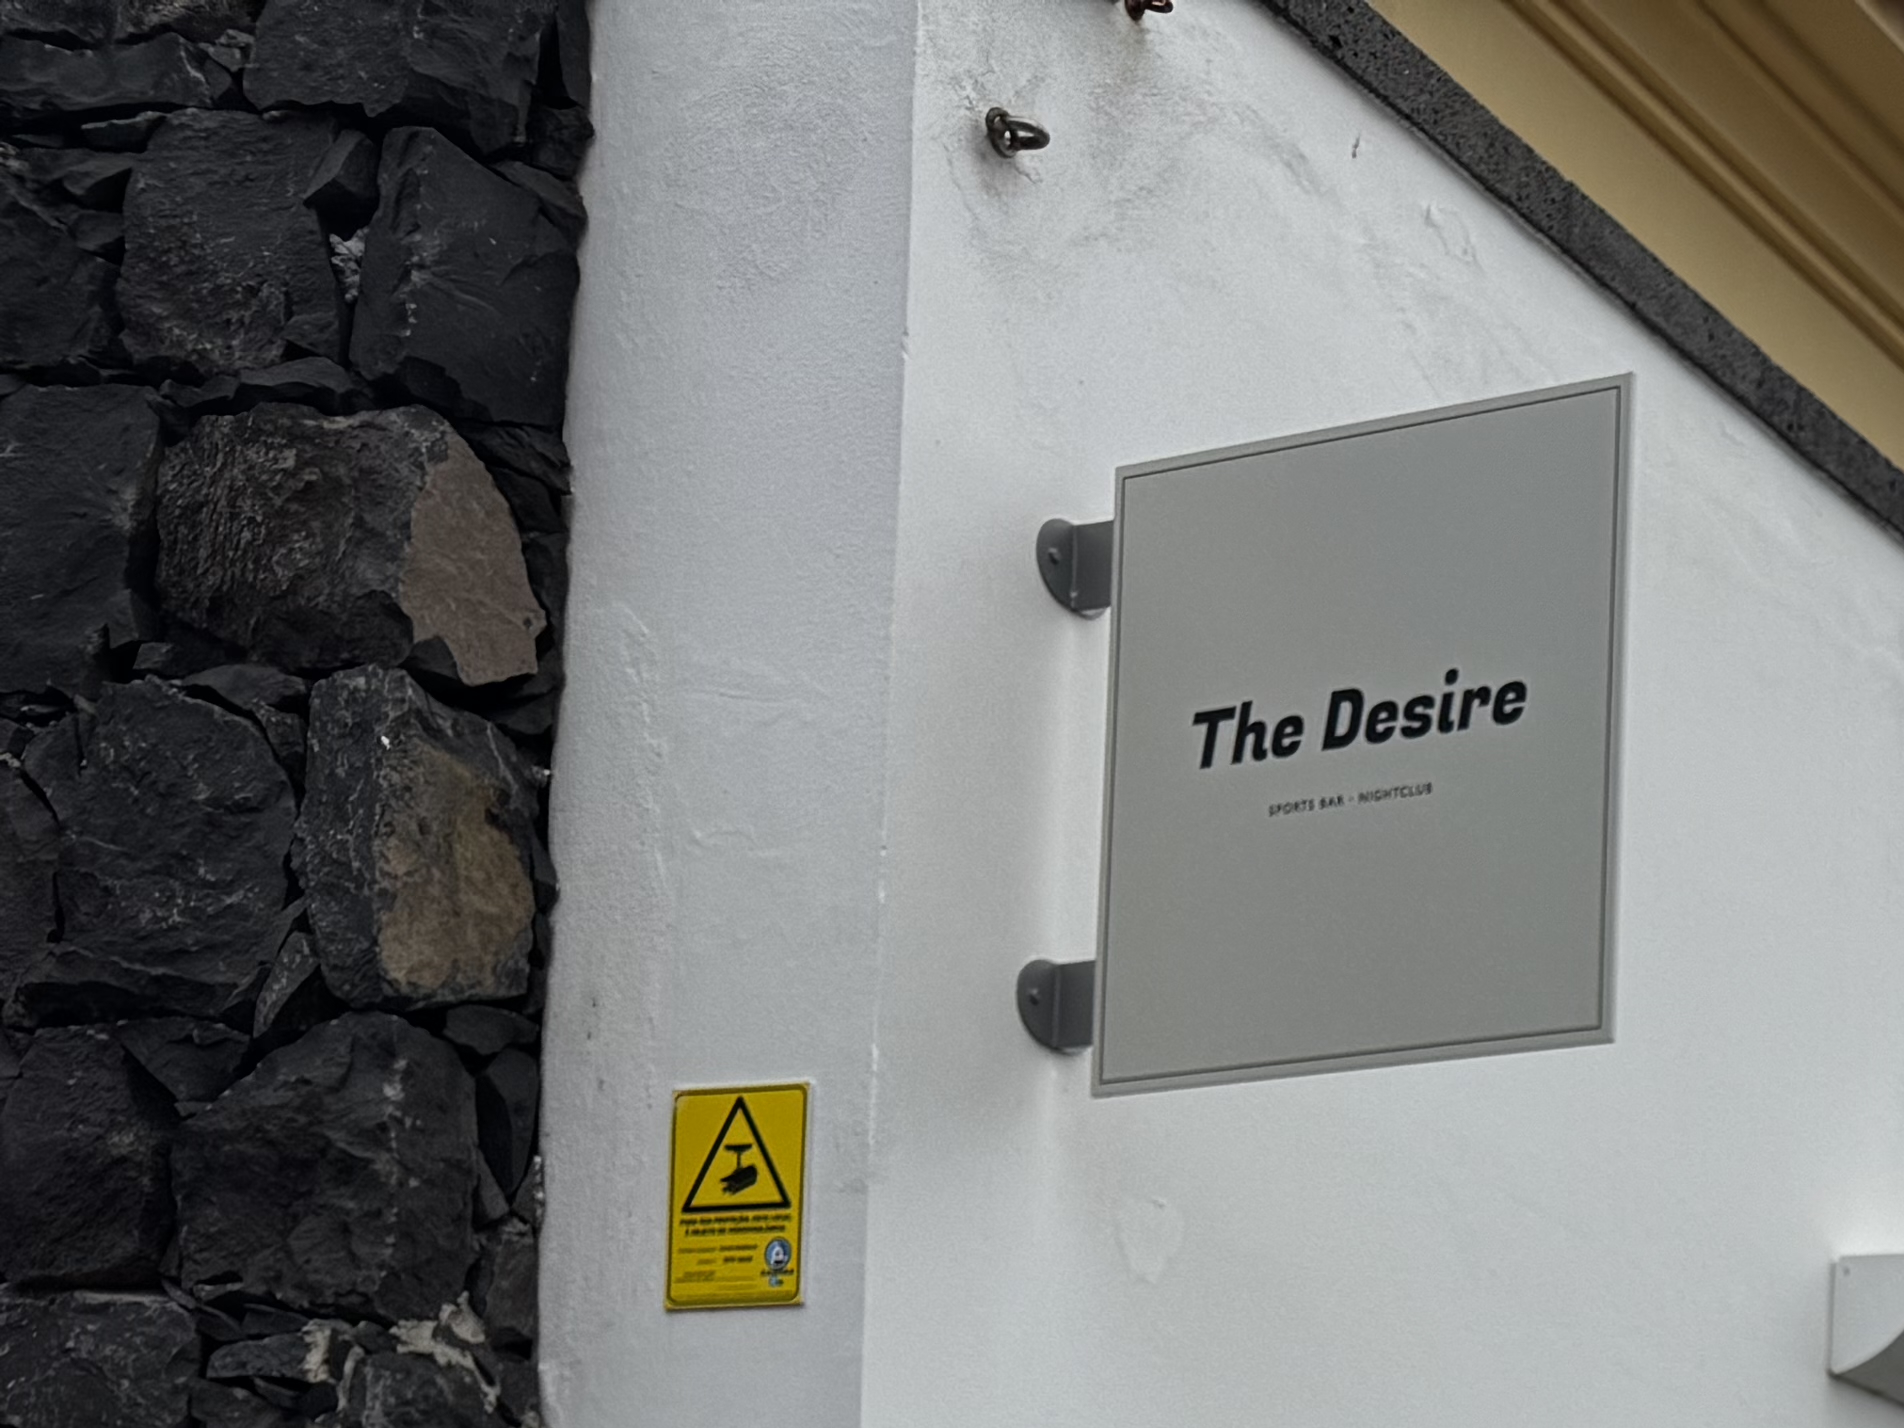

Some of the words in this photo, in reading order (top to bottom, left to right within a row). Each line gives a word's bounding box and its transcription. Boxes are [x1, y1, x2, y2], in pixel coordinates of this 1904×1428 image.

[1192, 700, 1305, 770] The
[1321, 668, 1528, 752] Desire
[1268, 798, 1316, 817] SPORTS
[1319, 794, 1345, 810] BAR
[1357, 782, 1434, 804] NIGHTCLUB
